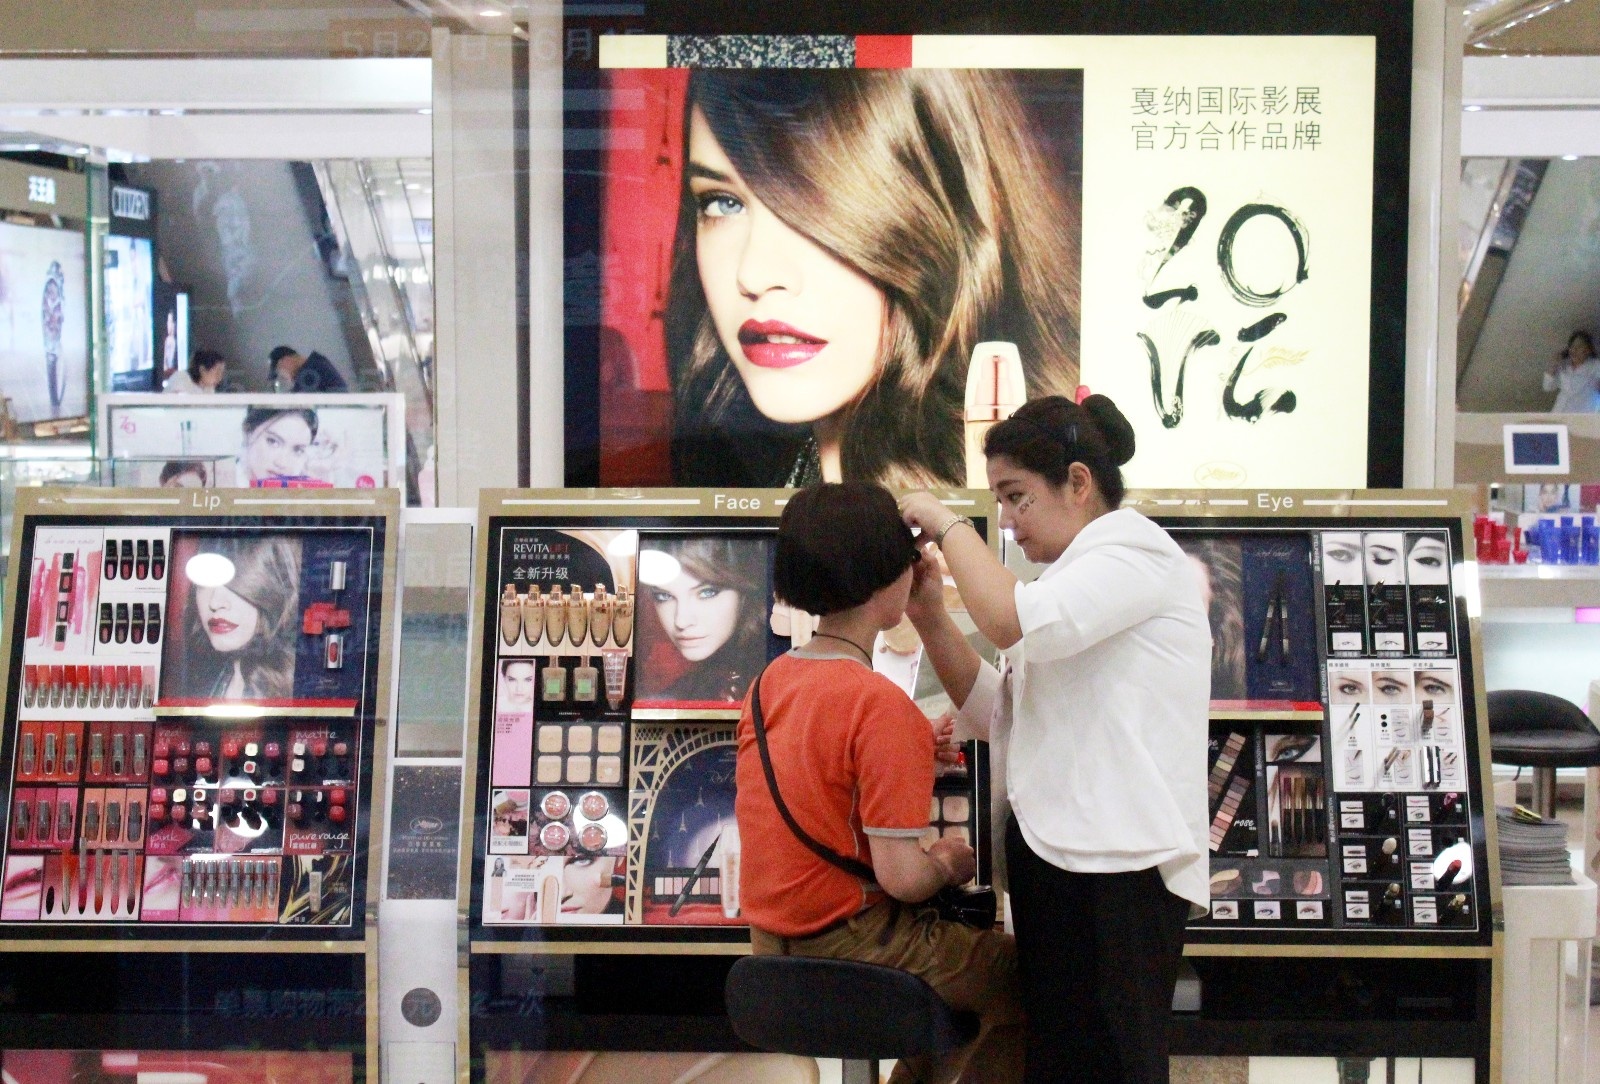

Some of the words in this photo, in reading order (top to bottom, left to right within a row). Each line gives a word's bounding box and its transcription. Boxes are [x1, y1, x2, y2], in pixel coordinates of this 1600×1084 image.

[1130, 85, 1322, 115] 戛纳国际影展
[1131, 121, 1322, 151] 官方合作品牌
[113, 186, 150, 221] CITIZEN
[191, 491, 221, 510] Lip
[713, 494, 761, 511] Face
[1256, 492, 1294, 510] Eye
[512, 566, 569, 580] 全新升级
[295, 726, 337, 739] matte
[1233, 819, 1255, 827] rose
